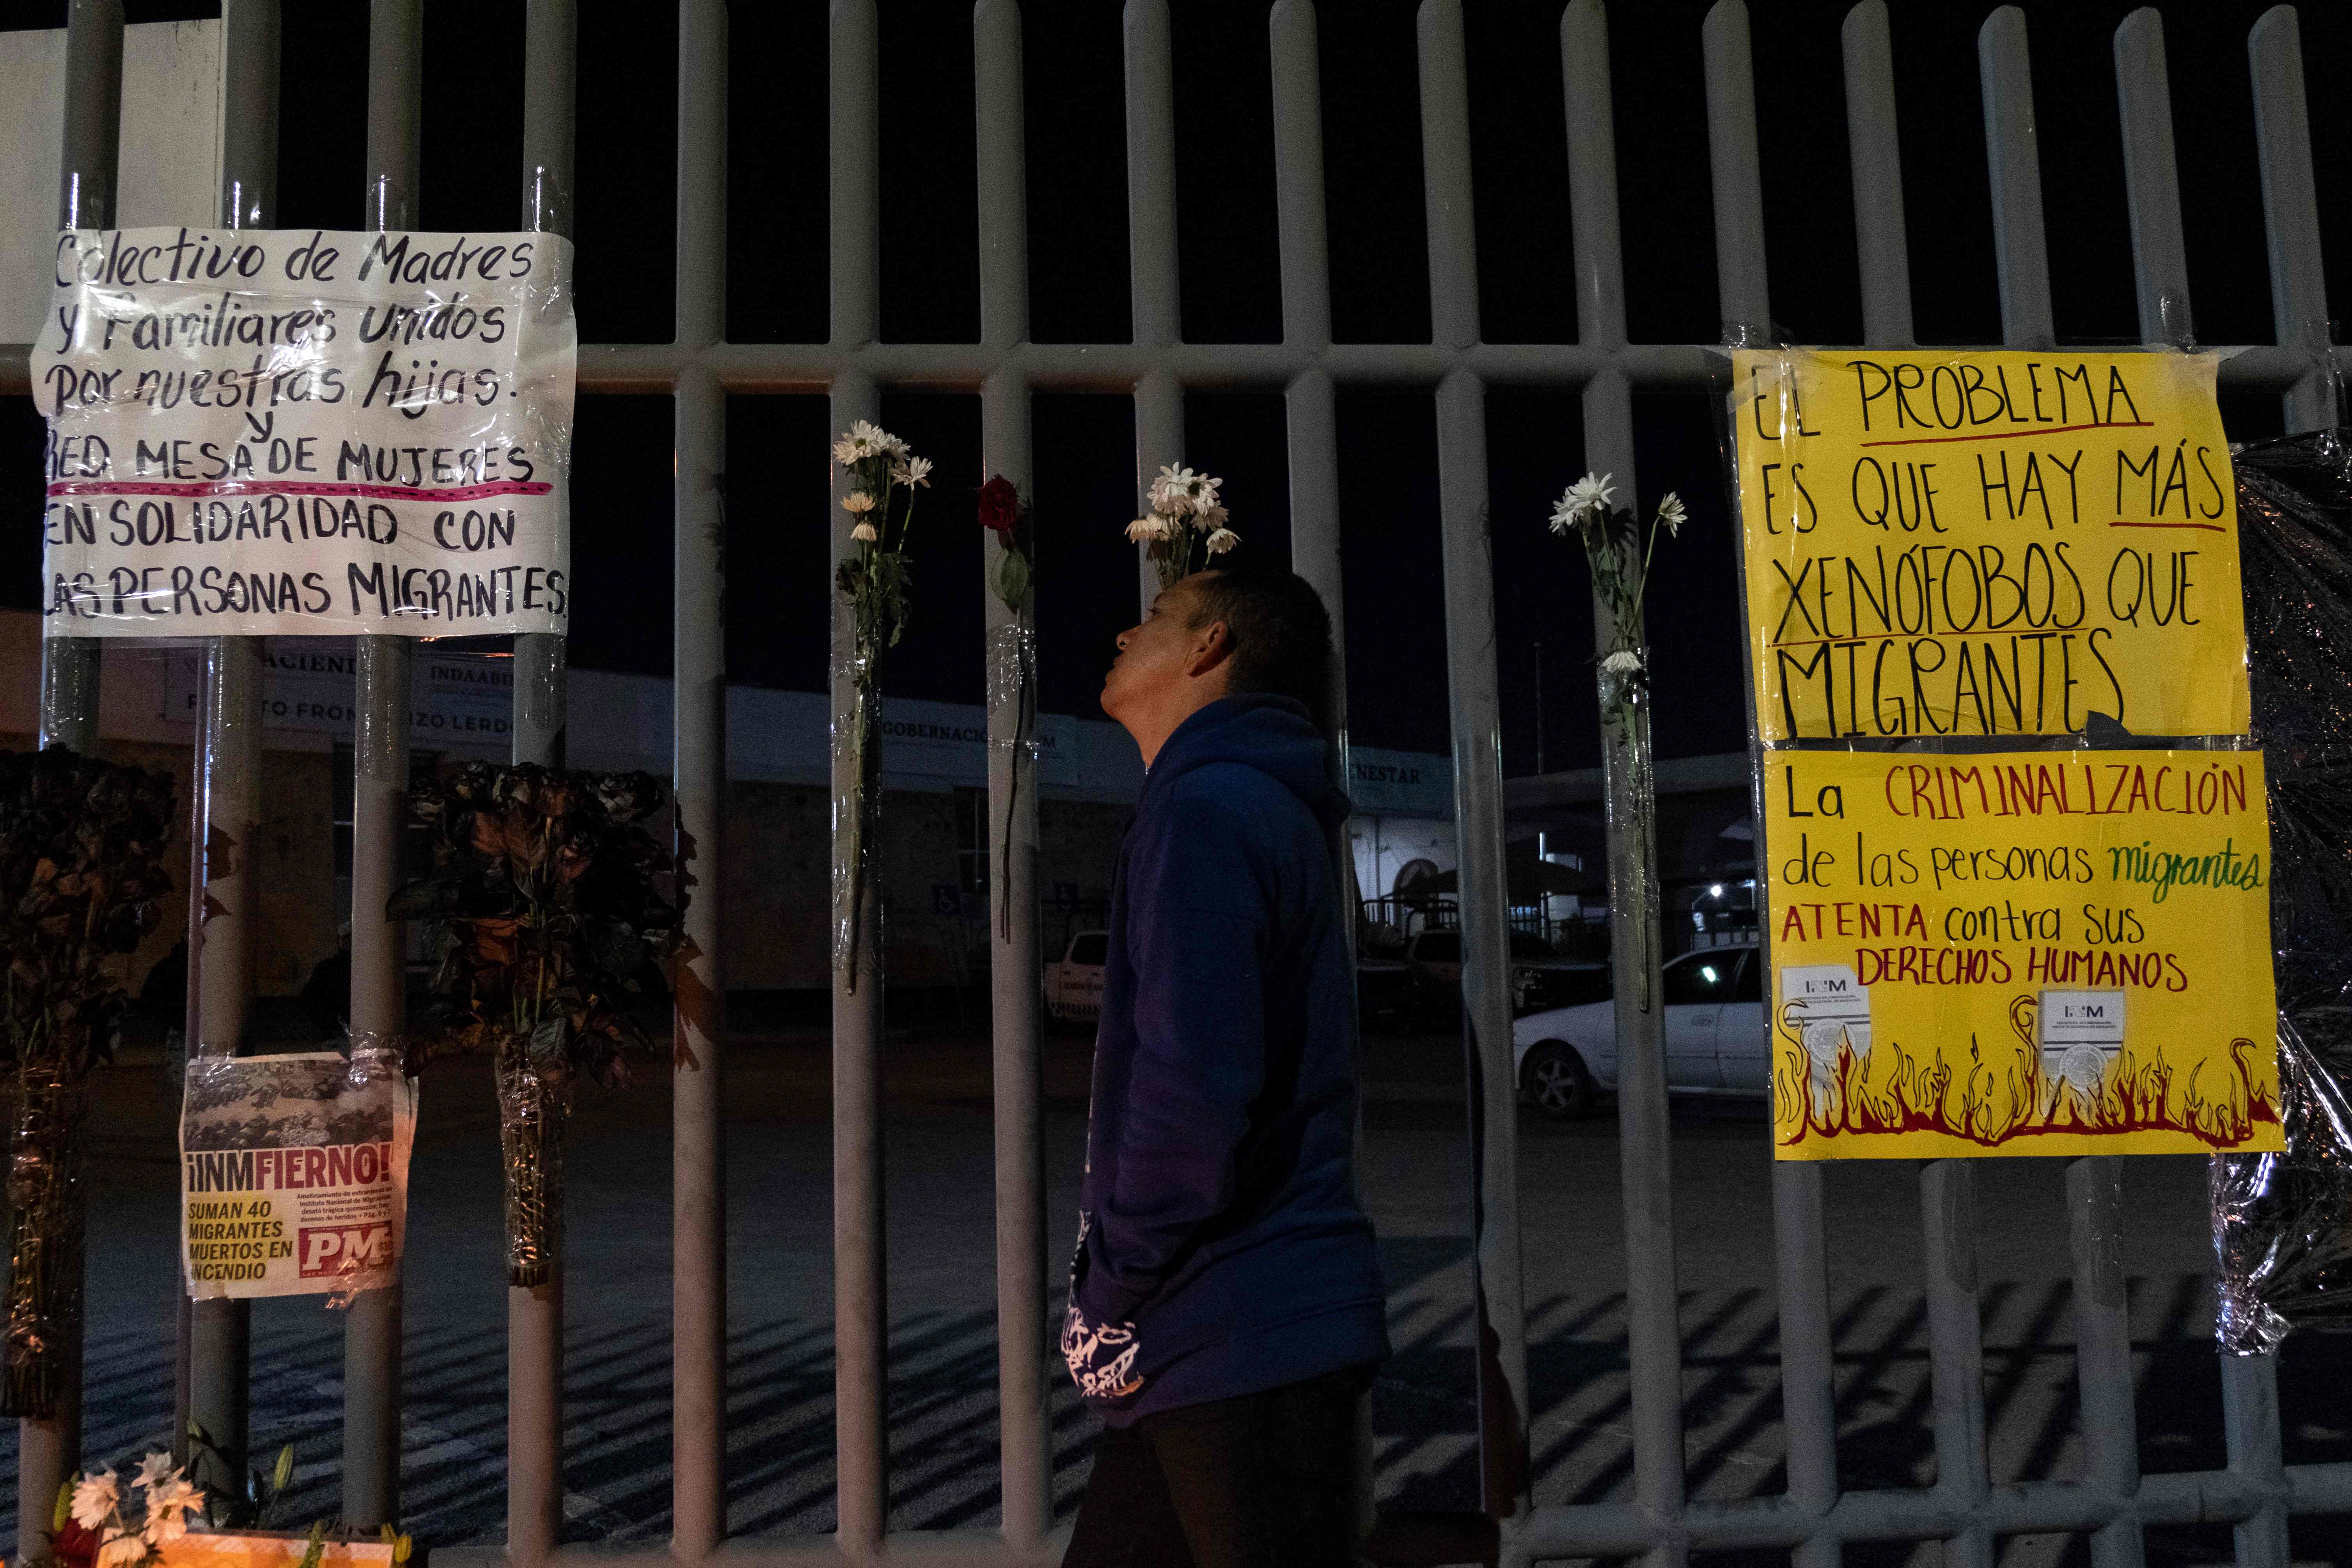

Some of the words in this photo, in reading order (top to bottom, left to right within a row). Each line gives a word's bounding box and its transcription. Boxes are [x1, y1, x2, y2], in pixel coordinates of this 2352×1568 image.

[56, 228, 265, 287] Colectivo
[285, 231, 339, 282] de
[358, 234, 534, 284] Madres
[56, 303, 79, 355] y
[103, 291, 336, 350] Familiares
[134, 355, 345, 409] nuestras
[362, 351, 517, 419] hijas.
[1751, 365, 1821, 440] EL
[1846, 360, 2141, 432] PROBLEMA
[245, 411, 273, 443] y
[44, 429, 110, 481] RED
[136, 440, 254, 480] MESA
[268, 437, 318, 474] DE
[337, 440, 534, 487] MUJERES
[1762, 463, 1817, 535] ES
[1852, 457, 1949, 533] QUE
[1977, 450, 2083, 530] HAY
[2117, 438, 2224, 520] MÁS
[46, 503, 96, 545] EN
[109, 494, 398, 546] SOLIDARIDAD
[433, 509, 514, 552] CON
[108, 566, 331, 615] PERSONAS
[1772, 542, 2085, 643] XENÓFOBOS
[2107, 547, 2200, 628] QUE
[1776, 628, 2124, 738] MIGRANTES
[1786, 765, 1844, 819] La
[1885, 762, 2247, 819] CRIMINALIZACIÓN
[1783, 832, 1835, 887] de
[1857, 831, 1918, 888] las
[1931, 845, 2093, 890] personas
[2107, 837, 2264, 904] migrantes
[1781, 902, 1928, 942] ATENTA
[1945, 899, 2061, 943] contra
[1855, 945, 2011, 986] DERECHOS
[2028, 946, 2187, 992] HUMANOS
[186, 1143, 390, 1192] ¡INMFIERNO!
[188, 1202, 243, 1220] SUMAN
[247, 1201, 271, 1218] 40
[189, 1220, 284, 1240] MIGRANTES
[189, 1242, 263, 1260] MUERTOS
[269, 1240, 293, 1258] EN
[191, 1262, 266, 1280] INCENDIO
